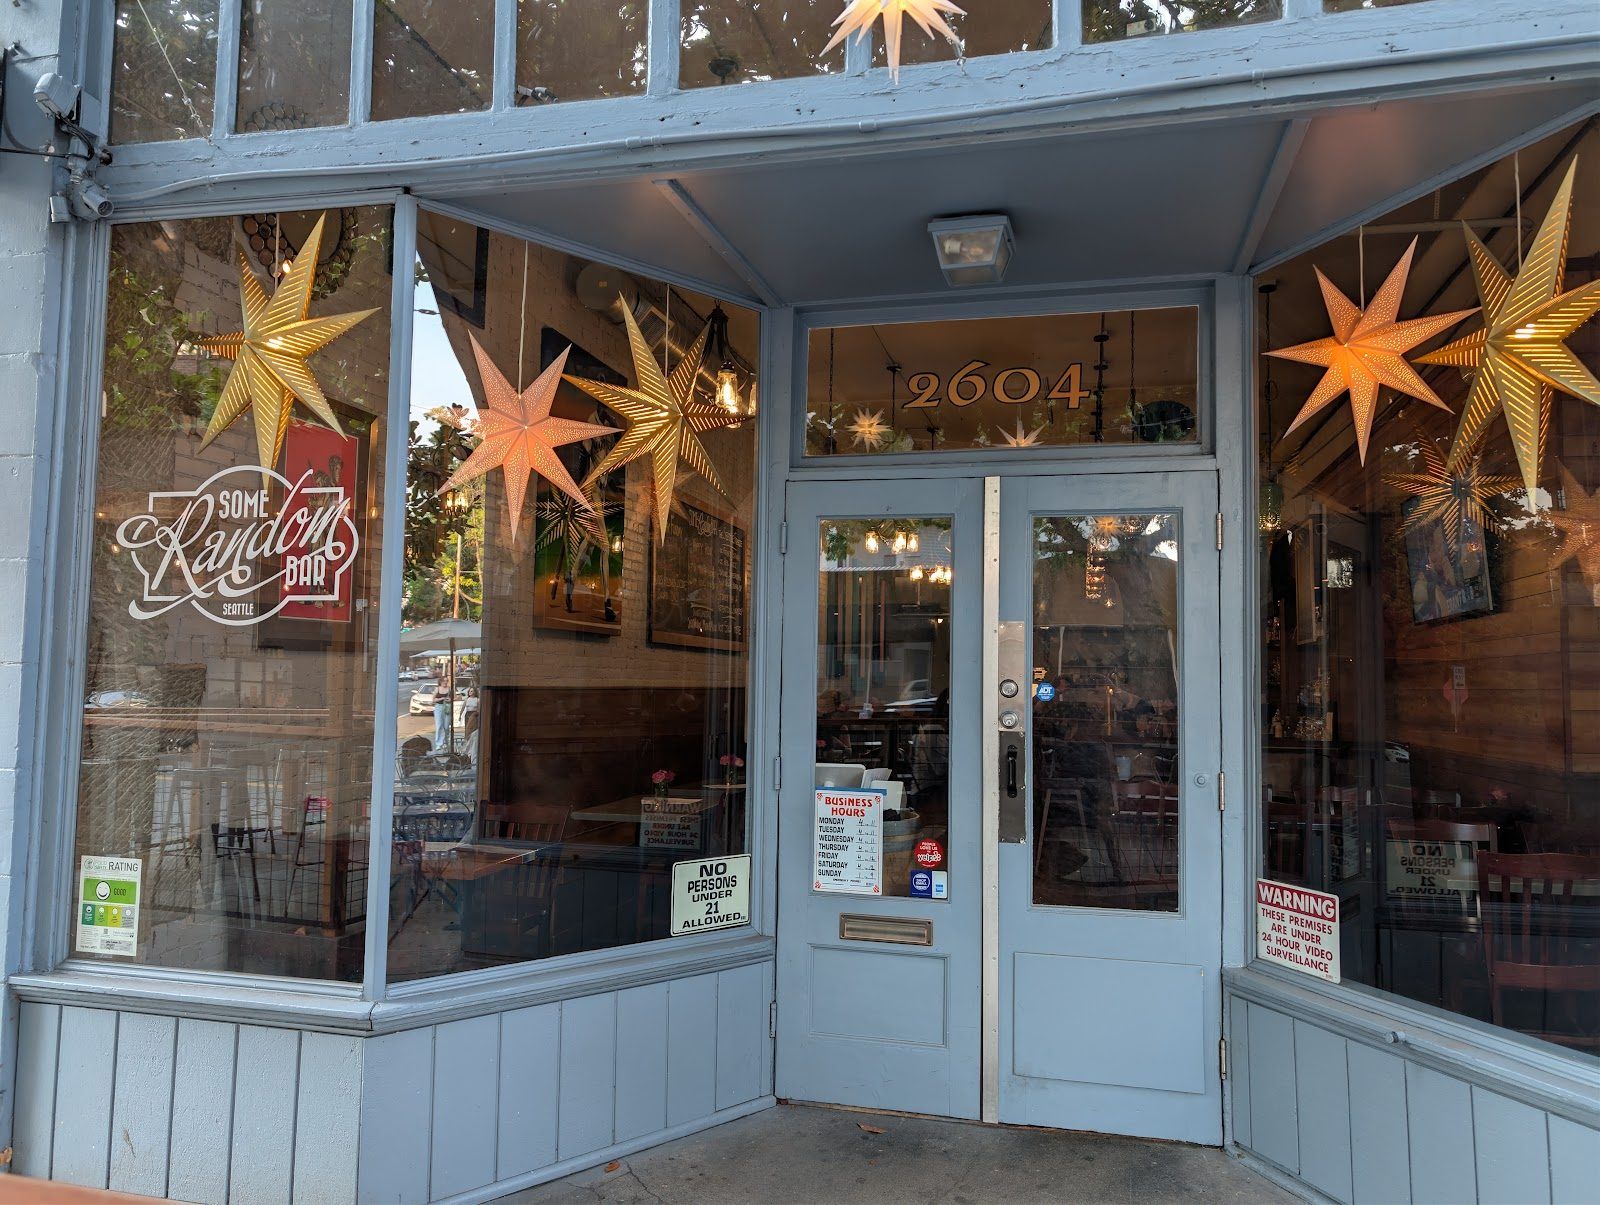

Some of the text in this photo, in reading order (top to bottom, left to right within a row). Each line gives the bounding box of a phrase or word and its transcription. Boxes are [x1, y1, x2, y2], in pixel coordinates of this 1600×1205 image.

[901, 359, 1092, 410] 2604
[218, 489, 269, 518] SOME
[116, 468, 351, 602] Random
[285, 555, 326, 586] BAR
[222, 602, 254, 616] SEATTLE
[1038, 686, 1053, 694] ADT
[831, 807, 866, 817] HOURS
[819, 817, 845, 825] MONDAY
[819, 825, 845, 834] TUESDAY
[819, 834, 855, 843] WEDNESDAY
[819, 842, 849, 851] THURSDAY
[818, 851, 839, 860] FRIDAY
[108, 861, 139, 872] RATING
[699, 862, 728, 878] NO
[818, 860, 849, 869] SATURDAY
[818, 868, 842, 877] SUNDAY
[687, 875, 738, 894] PERSONS
[113, 888, 127, 896] GOOD
[692, 889, 733, 903] UNDER
[705, 900, 720, 915] 21
[1258, 883, 1335, 919] WARNING
[682, 912, 741, 929] ALLOWED
[1261, 907, 1333, 935] THESE PREMISES
[1270, 922, 1322, 946] ARE UNDER
[1261, 931, 1333, 961] 24 HOUR VIDEO
[1266, 945, 1329, 974] SURVEILLANCE
